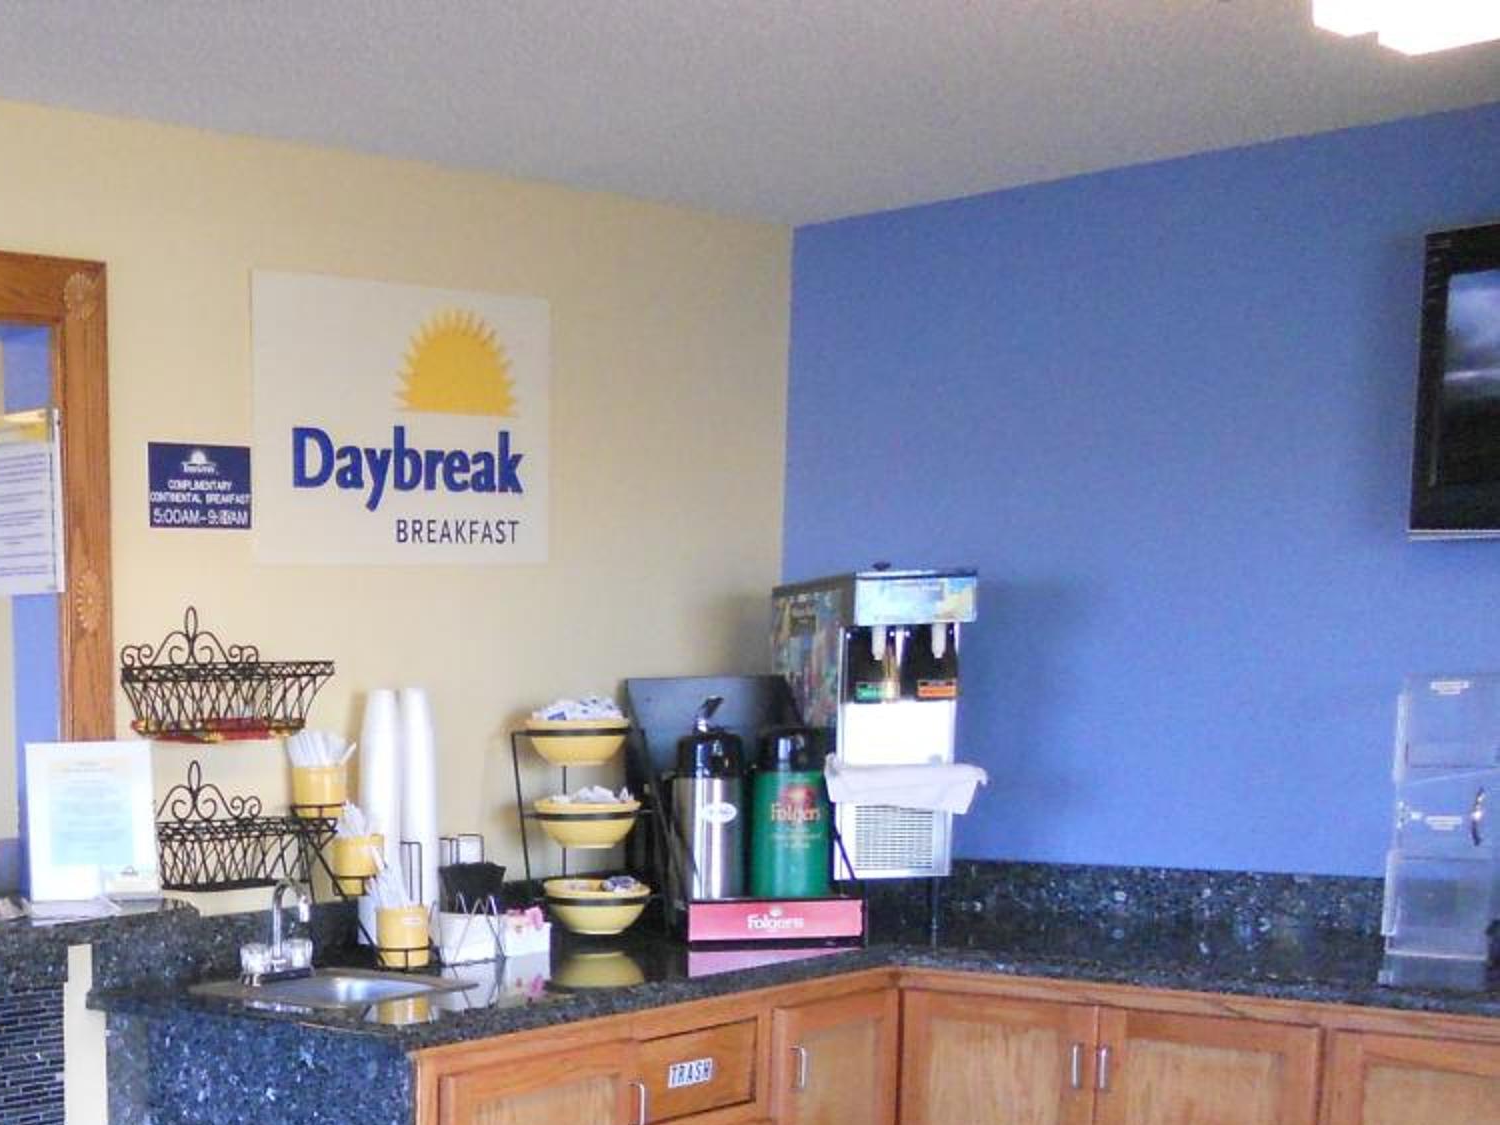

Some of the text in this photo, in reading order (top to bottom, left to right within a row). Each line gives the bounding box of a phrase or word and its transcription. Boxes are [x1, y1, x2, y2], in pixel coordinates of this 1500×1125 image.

[292, 425, 524, 511] Daybreak
[395, 518, 519, 544] BREAKFAST
[670, 1061, 712, 1085] TRASH
